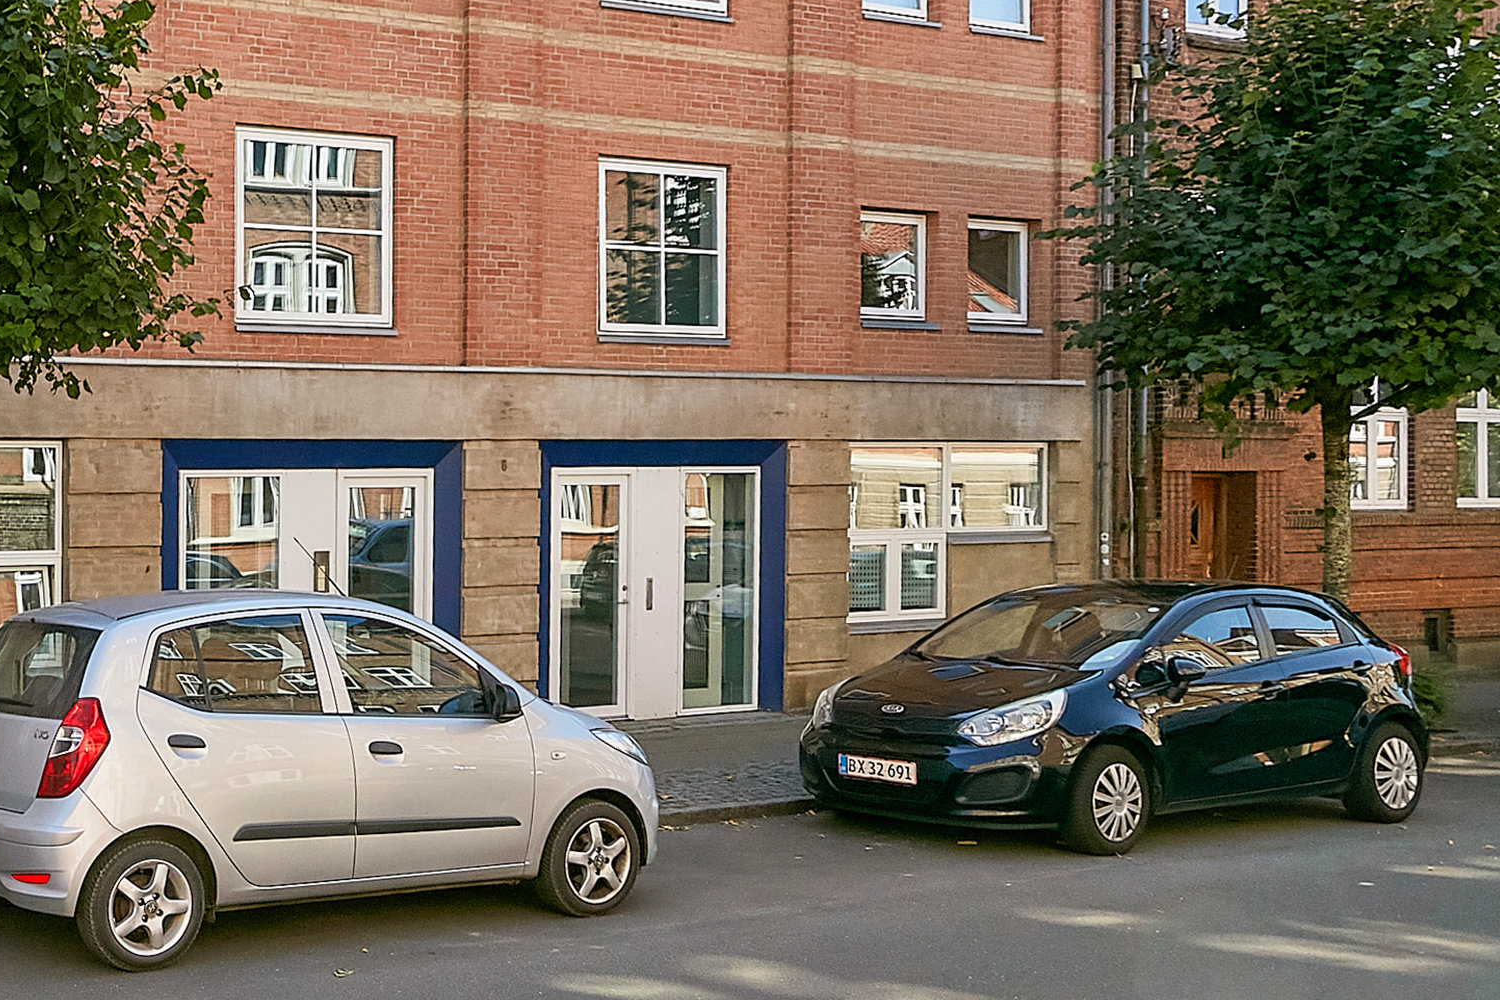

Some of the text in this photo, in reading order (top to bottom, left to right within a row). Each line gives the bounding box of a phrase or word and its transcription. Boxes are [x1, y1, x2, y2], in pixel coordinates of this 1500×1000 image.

[848, 758, 912, 781] BX 32 691
